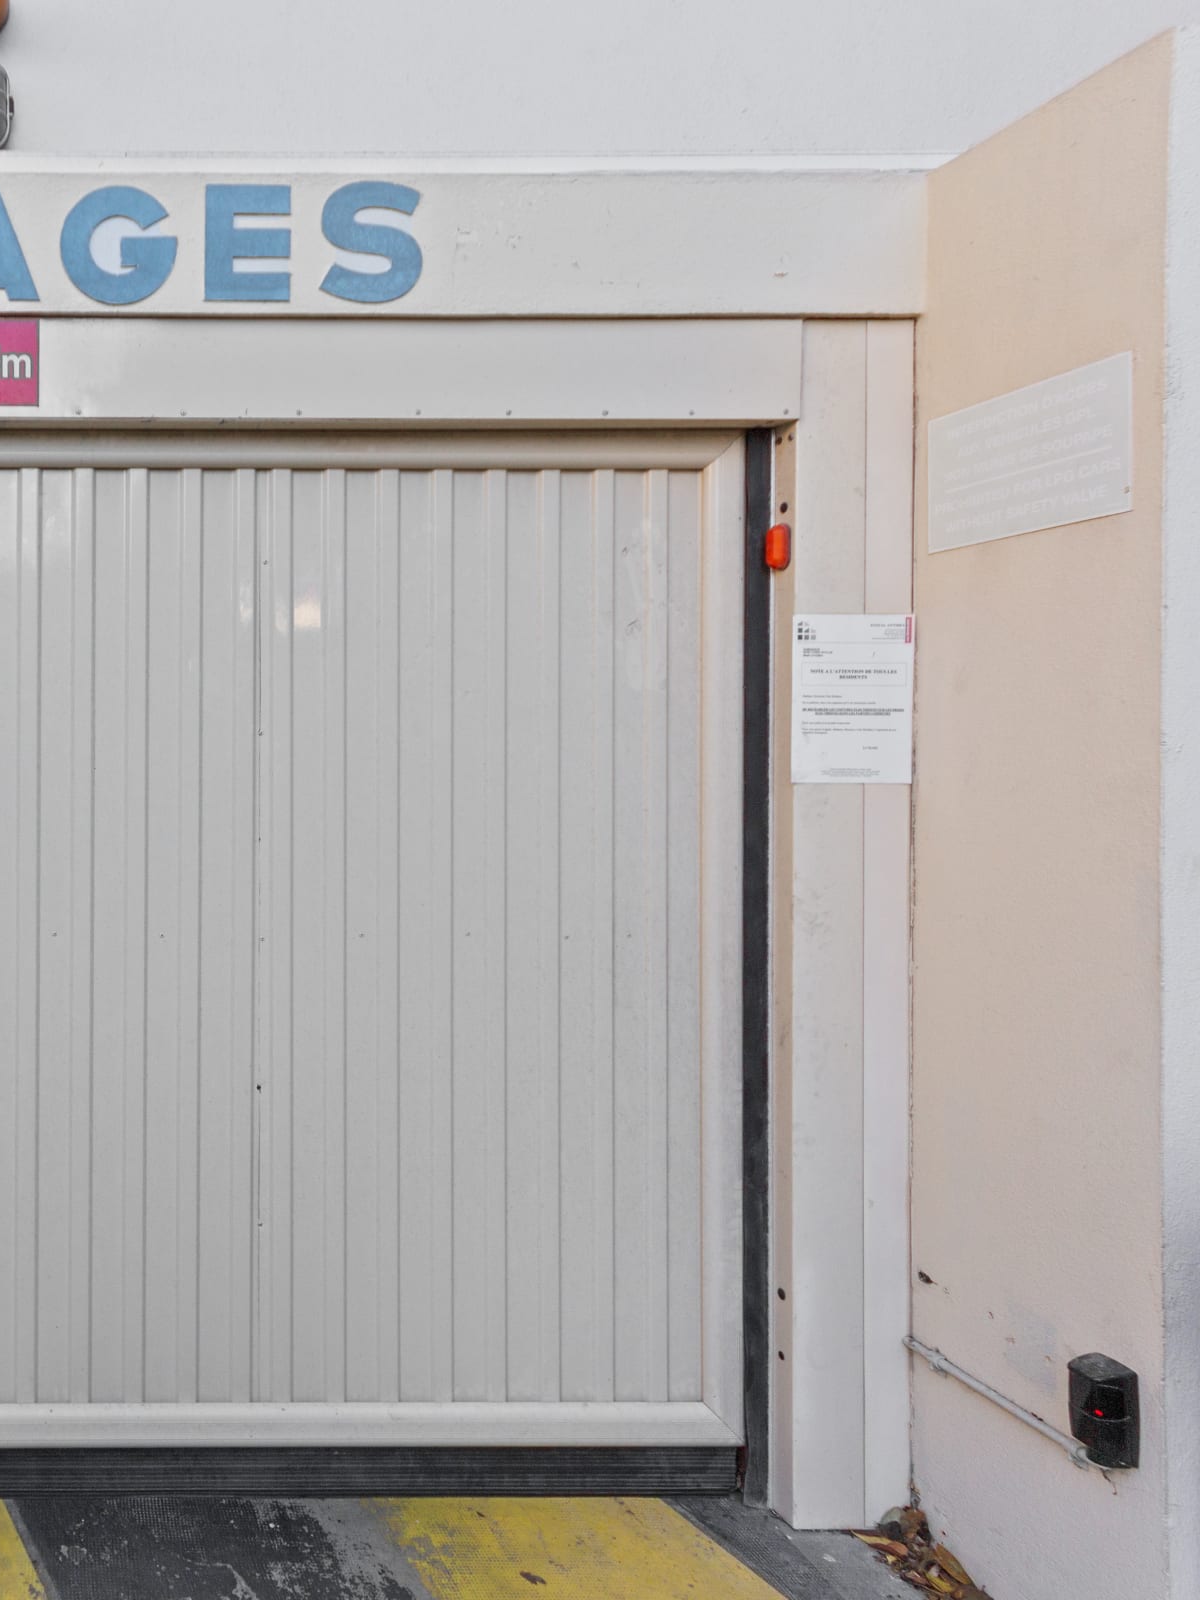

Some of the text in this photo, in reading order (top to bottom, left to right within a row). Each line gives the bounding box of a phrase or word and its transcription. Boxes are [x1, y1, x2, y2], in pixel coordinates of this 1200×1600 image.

[985, 415, 1063, 449] VEHICULES
[1013, 479, 1040, 495] FOR
[1079, 457, 1120, 478] CARS
[1007, 497, 1058, 519] SAFETY
[1062, 484, 1107, 505] VALVE
